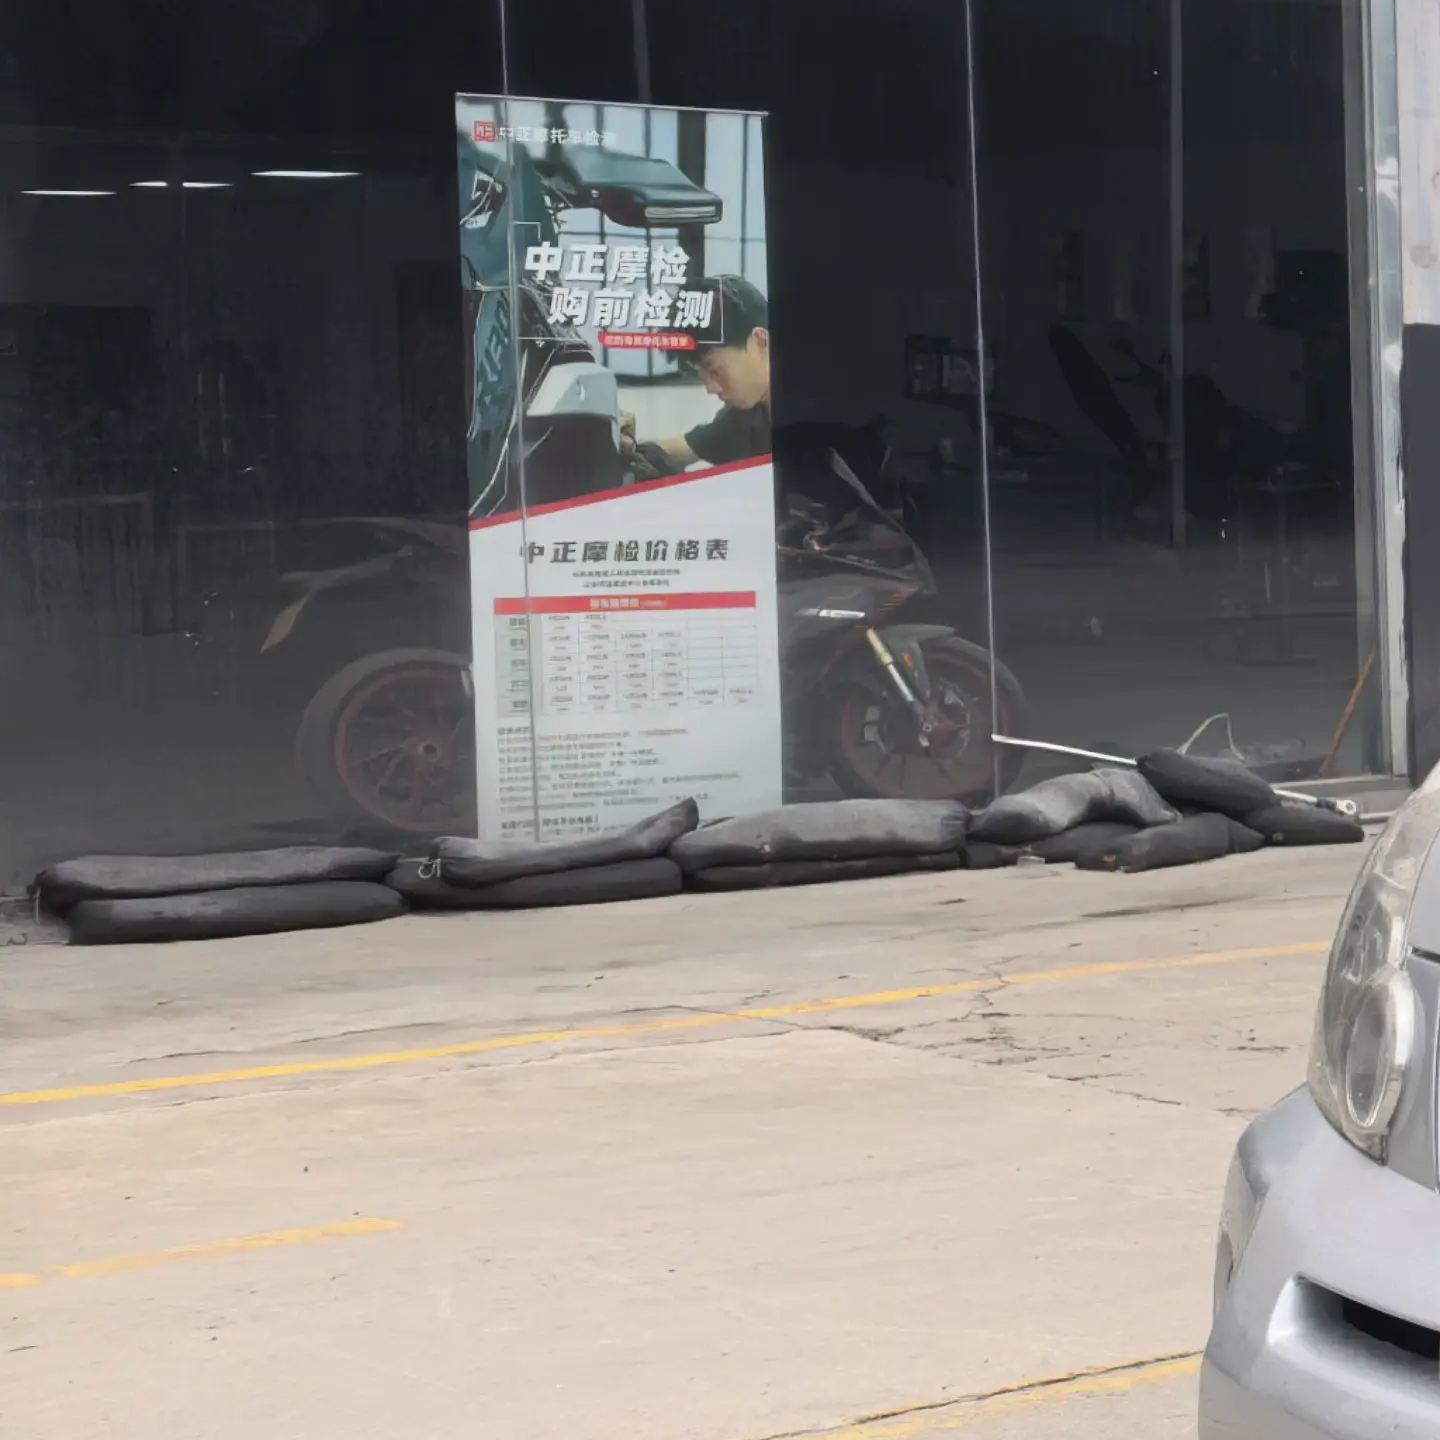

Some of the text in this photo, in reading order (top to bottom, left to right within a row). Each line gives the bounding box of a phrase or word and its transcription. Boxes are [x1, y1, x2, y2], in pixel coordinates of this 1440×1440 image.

[524, 240, 691, 285] 中正摩检
[546, 286, 714, 329] 购前检测
[519, 538, 729, 565] 中正摩检价格表
